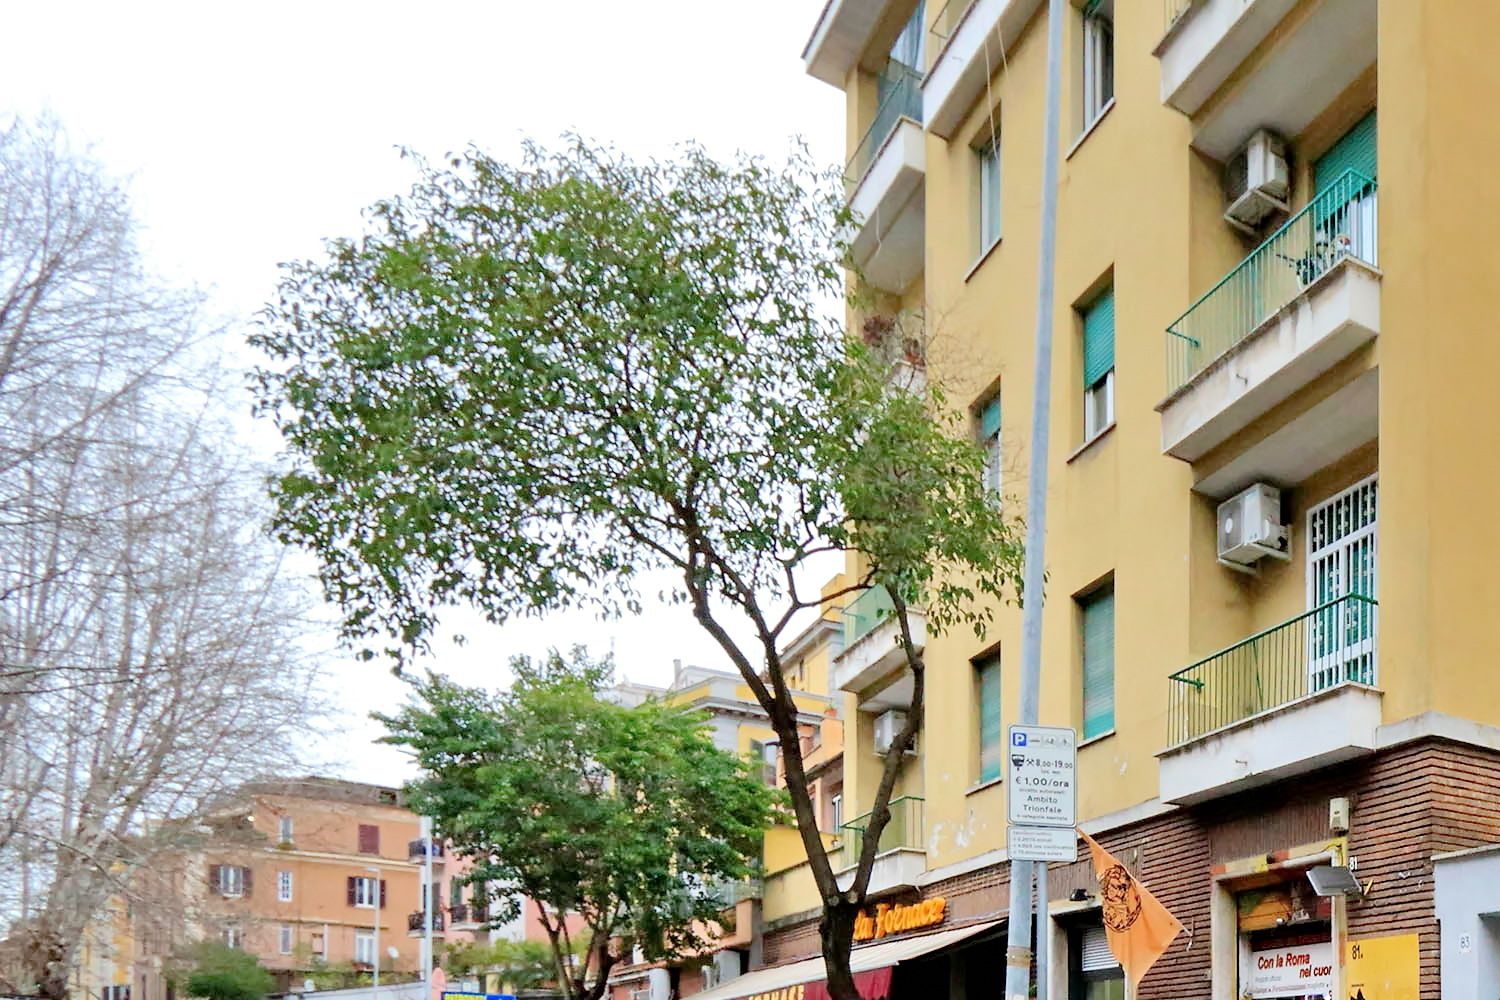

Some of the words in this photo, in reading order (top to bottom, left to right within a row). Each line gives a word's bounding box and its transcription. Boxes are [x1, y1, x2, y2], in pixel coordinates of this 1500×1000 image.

[1027, 795, 1058, 804] Ambito
[1023, 804, 1062, 814] Trionfale
[1257, 956, 1274, 970] Con
[1276, 954, 1284, 968] la
[1286, 953, 1310, 967] Roma
[1299, 965, 1312, 978] nel
